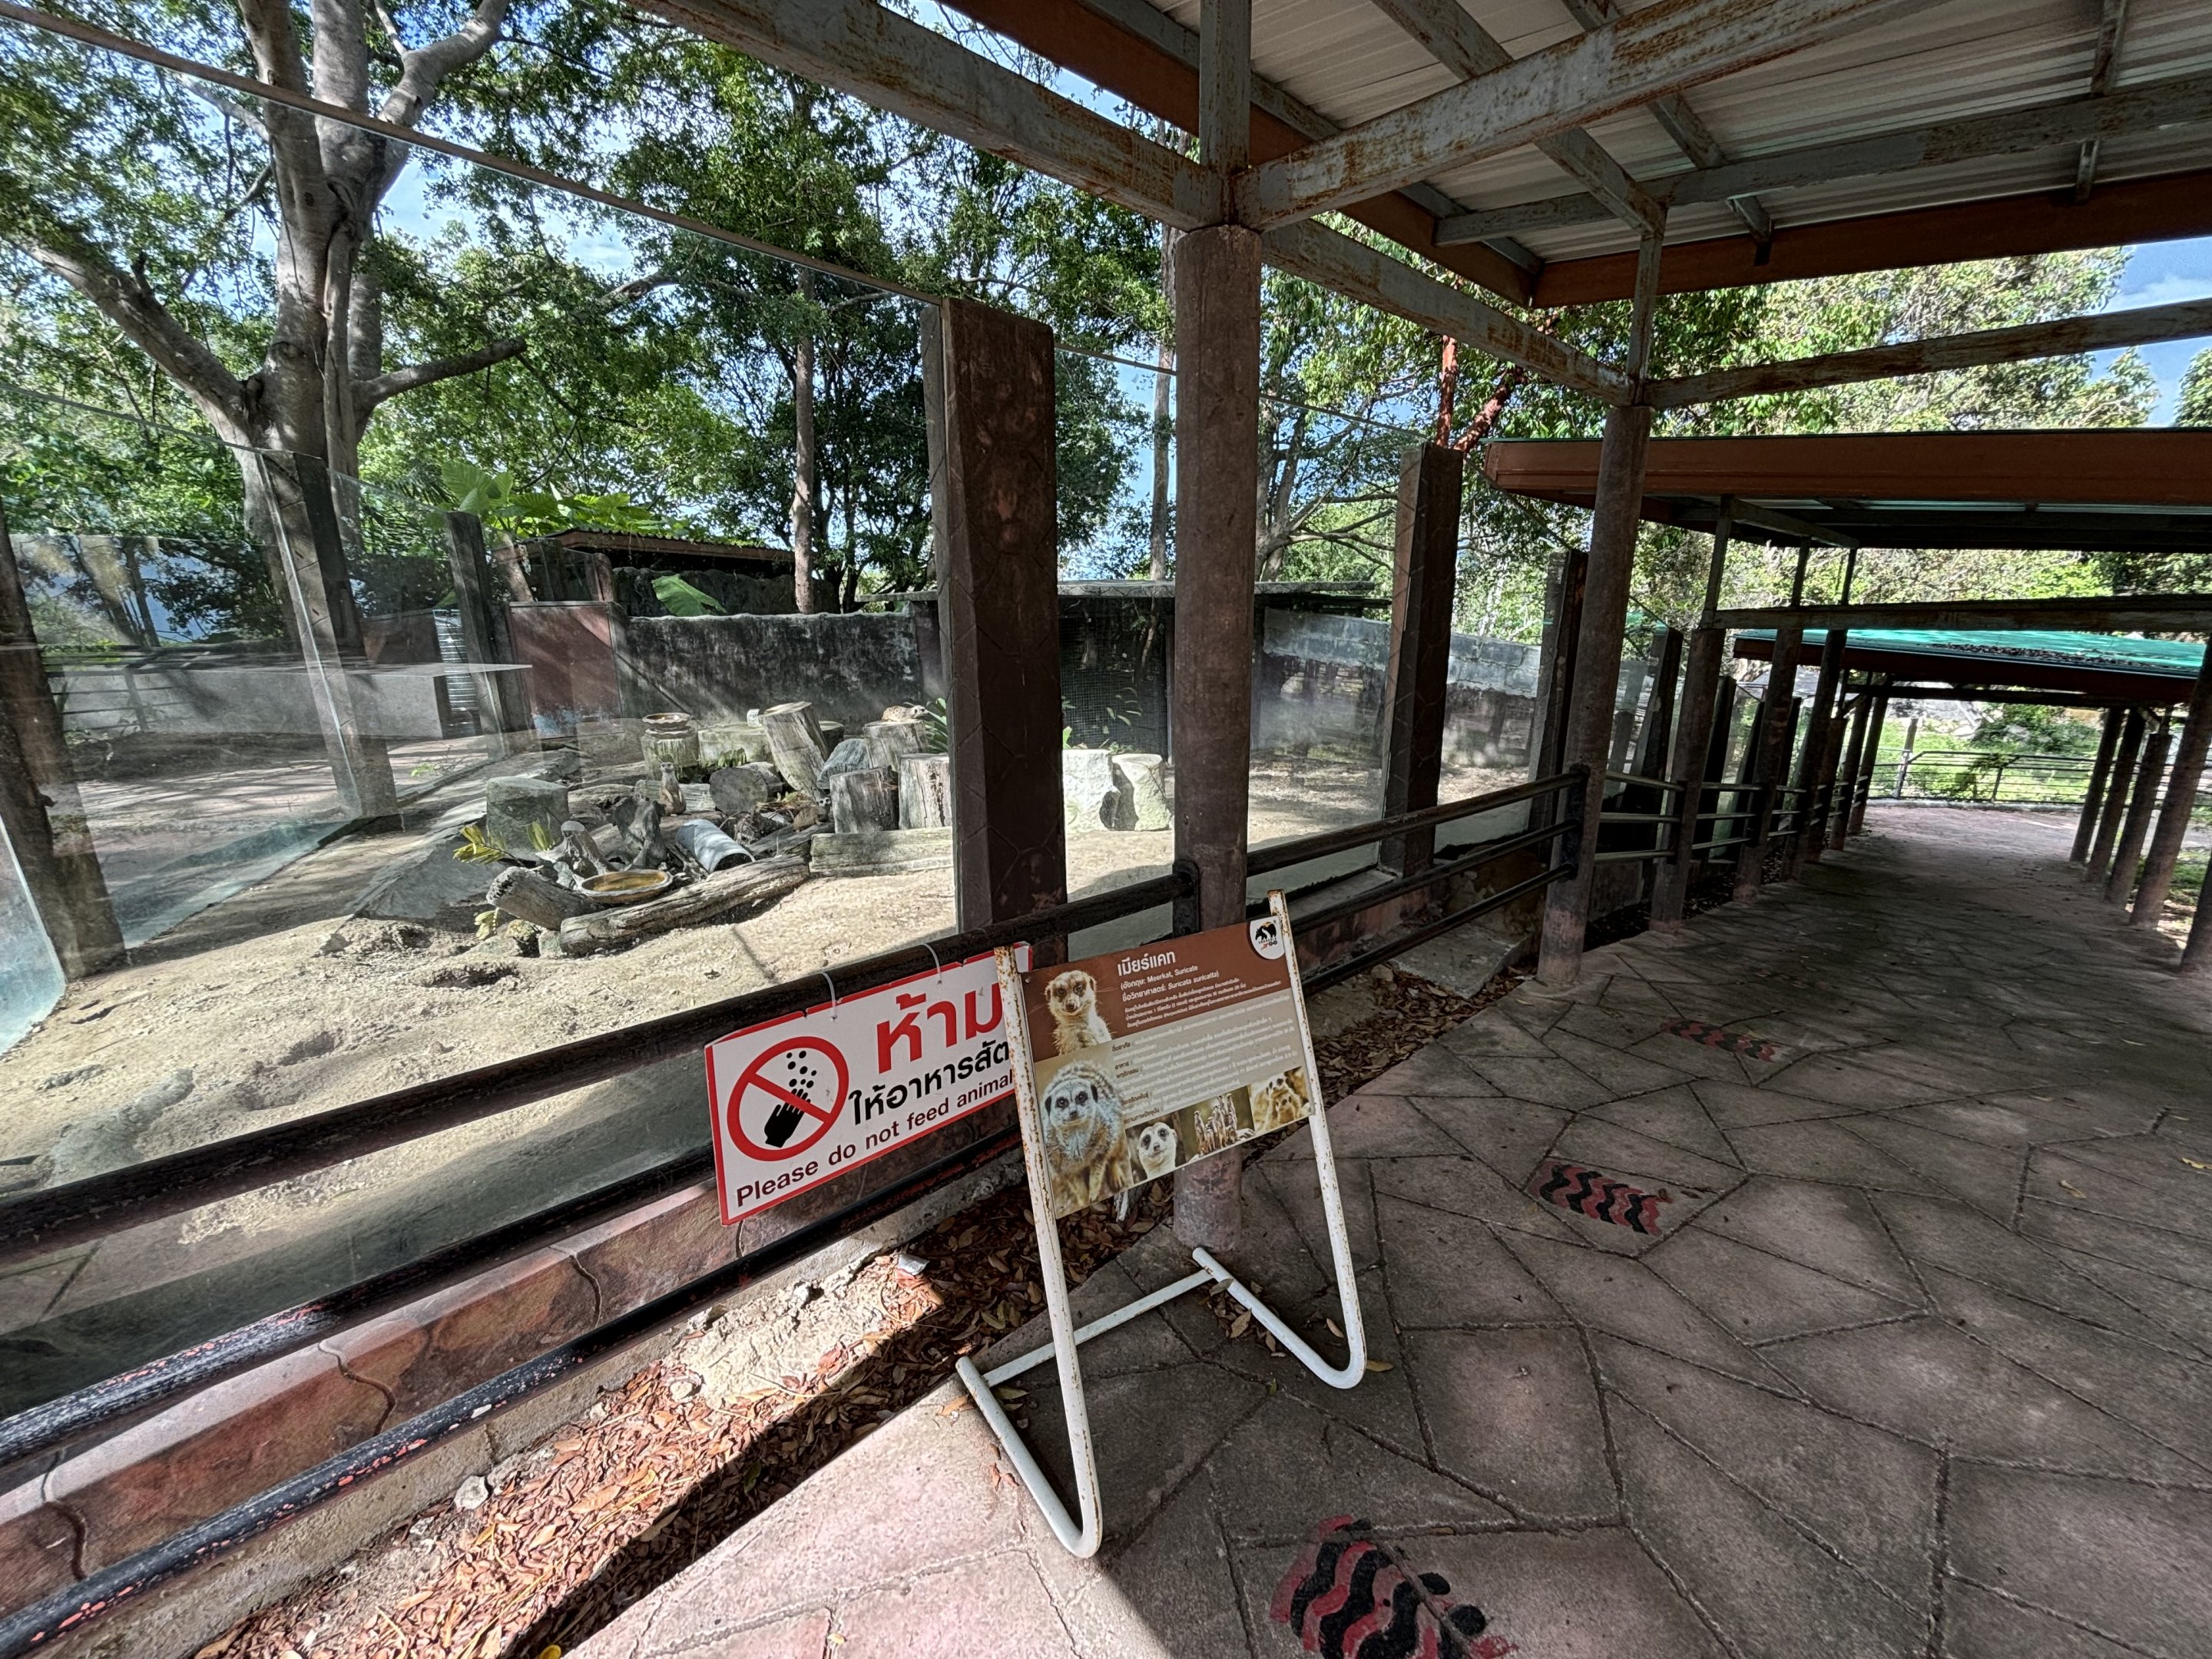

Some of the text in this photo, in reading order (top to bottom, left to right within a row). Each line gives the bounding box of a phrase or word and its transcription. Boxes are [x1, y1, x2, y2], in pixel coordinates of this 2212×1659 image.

[1117, 952, 1176, 976] เมียร์แคท
[1147, 972, 1174, 983] Meerkat,
[1174, 965, 1198, 976] Suricate
[1167, 979, 1192, 990] Suricata
[1193, 970, 1219, 983] suricatta)
[876, 982, 1003, 1075] ห้าม
[849, 1039, 1009, 1125] ให้อาหารสัต
[737, 1161, 819, 1207] Please
[828, 1144, 856, 1166] do
[866, 1121, 899, 1150] not
[907, 1094, 949, 1131] feed
